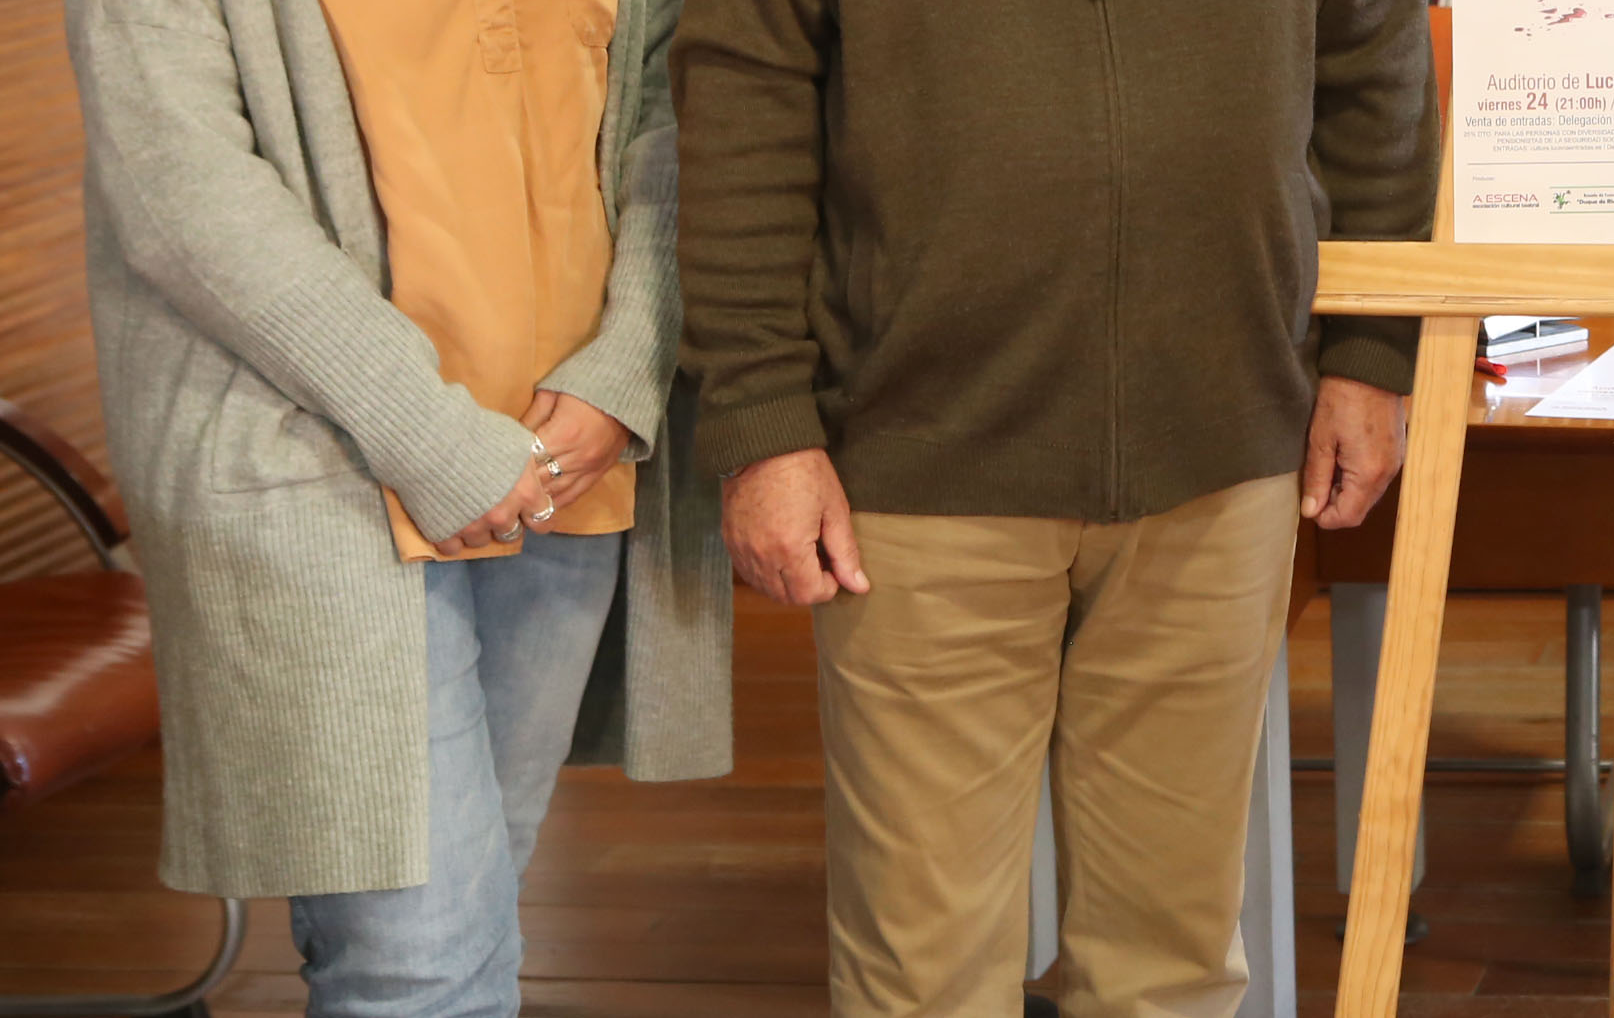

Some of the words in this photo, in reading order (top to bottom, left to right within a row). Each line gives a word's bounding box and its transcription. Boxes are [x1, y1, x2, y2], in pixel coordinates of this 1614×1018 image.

[1487, 73, 1556, 91] Auditorio
[1561, 73, 1580, 90] de
[1477, 98, 1521, 111] viernes
[1526, 92, 1548, 111] 24
[1555, 97, 1607, 113] (21:00h)
[1465, 116, 1492, 127] Venta
[1495, 115, 1507, 126] de
[1510, 115, 1554, 126] entradas:
[1558, 114, 1612, 128] Delegación
[1473, 195, 1483, 203] A
[1486, 194, 1539, 203] ESCENA
